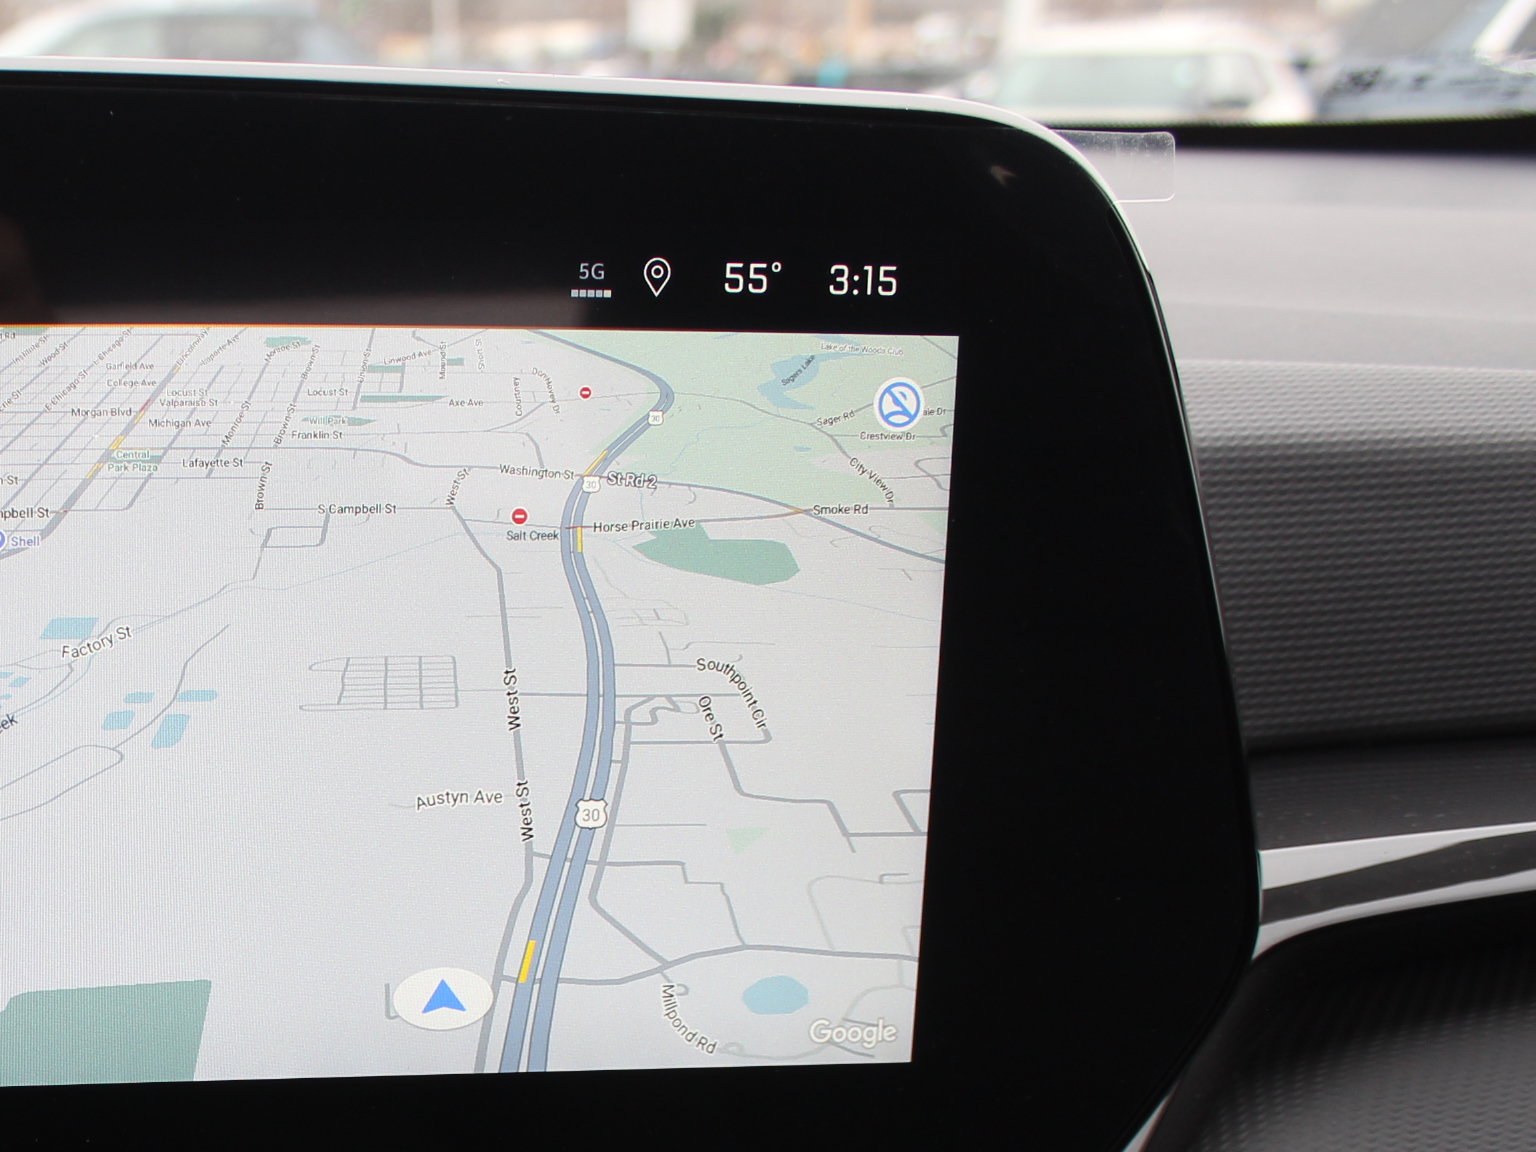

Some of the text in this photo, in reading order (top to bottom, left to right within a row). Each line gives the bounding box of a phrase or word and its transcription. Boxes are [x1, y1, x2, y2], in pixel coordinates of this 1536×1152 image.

[579, 263, 605, 280] 5G
[724, 262, 781, 294] 55°
[830, 264, 897, 295] 3:15
[4, 332, 16, 340] Rd
[176, 328, 209, 366] Lincolnway
[820, 342, 904, 356] Lake of the Woods Club
[384, 350, 432, 365] Linwood Ave
[106, 362, 154, 371] Garfield Ave
[781, 354, 815, 386] Sagers Lake
[106, 379, 157, 388] College Ave
[166, 388, 208, 397] Locust St
[307, 388, 348, 397] Locust St
[513, 376, 522, 416] Courtney
[159, 398, 218, 408] Valparaiso St
[449, 398, 484, 407] Axe Ave
[71, 407, 132, 418] Morgan Blvd
[816, 410, 855, 427] Sager Rd
[148, 418, 212, 429] Michigan Ave
[223, 400, 252, 447] Monroe St
[273, 402, 297, 447] Brown St
[291, 430, 343, 439] Franklin St
[859, 431, 916, 441] Crestview Dr
[115, 450, 150, 459] Central
[107, 463, 158, 472] Park Plaza
[182, 458, 243, 469] Lafayette St
[499, 463, 575, 480] Washington St
[6, 475, 18, 485] St
[254, 461, 273, 510] Brown St
[445, 468, 470, 506] West St
[607, 472, 658, 489] St Rd 2
[849, 457, 894, 504] City View Dr
[36, 507, 50, 518] St
[317, 503, 397, 516] S Campbell St
[813, 504, 869, 515] Smoke Rd
[593, 518, 695, 533] Horse Prairie Ave
[11, 535, 41, 547] Shell
[506, 530, 559, 541] Salt Creek
[61, 625, 133, 659] Factory St
[503, 668, 522, 732] West St
[696, 657, 768, 730] Southpoint Cir
[698, 695, 725, 742] Ore St
[416, 789, 503, 811] Austyn Ave
[516, 780, 535, 842] West St
[582, 809, 600, 822] 30
[661, 984, 717, 1055] Millpond Rd
[809, 1017, 897, 1048] Google
